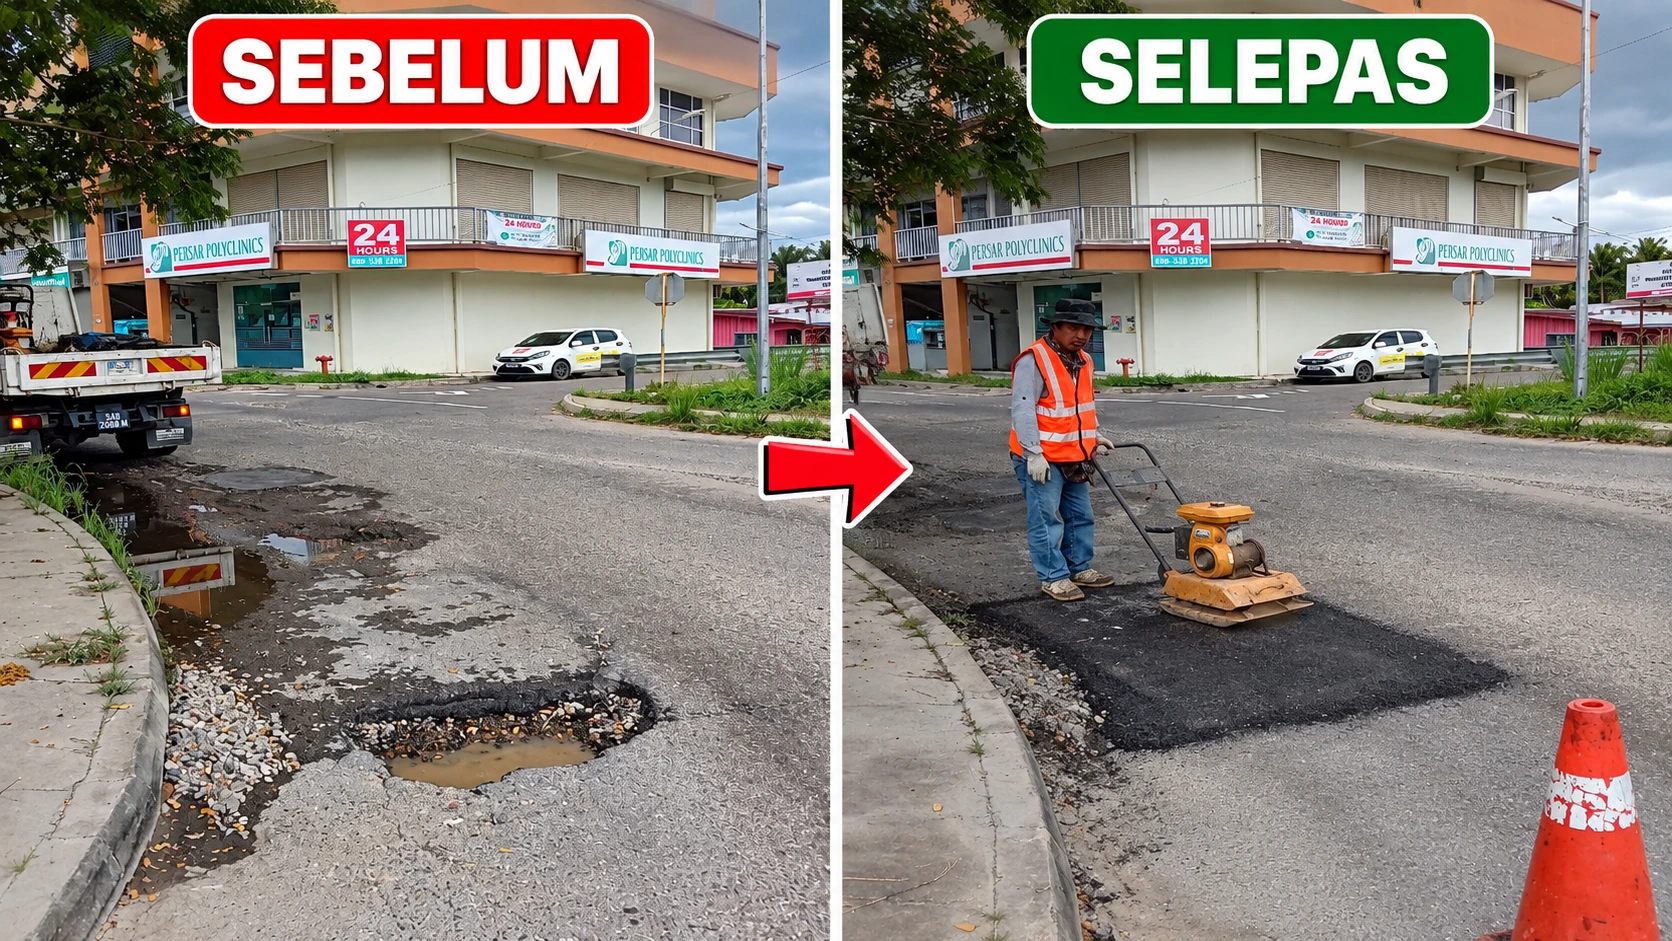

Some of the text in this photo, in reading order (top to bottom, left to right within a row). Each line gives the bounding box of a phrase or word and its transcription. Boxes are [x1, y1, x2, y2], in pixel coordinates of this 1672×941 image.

[353, 223, 400, 247] 24
[1156, 221, 1205, 246] 24
[173, 236, 264, 262] PERSAR POLYCLINICS
[356, 246, 398, 255] HOURS
[630, 246, 704, 265] PERSAR POLYCLINICS
[971, 235, 1065, 261] PERSAR POLYCLINICS
[1160, 245, 1203, 254] HOURS
[1438, 243, 1515, 263] PERSAR POLYCLINICS
[121, 419, 129, 427] M
